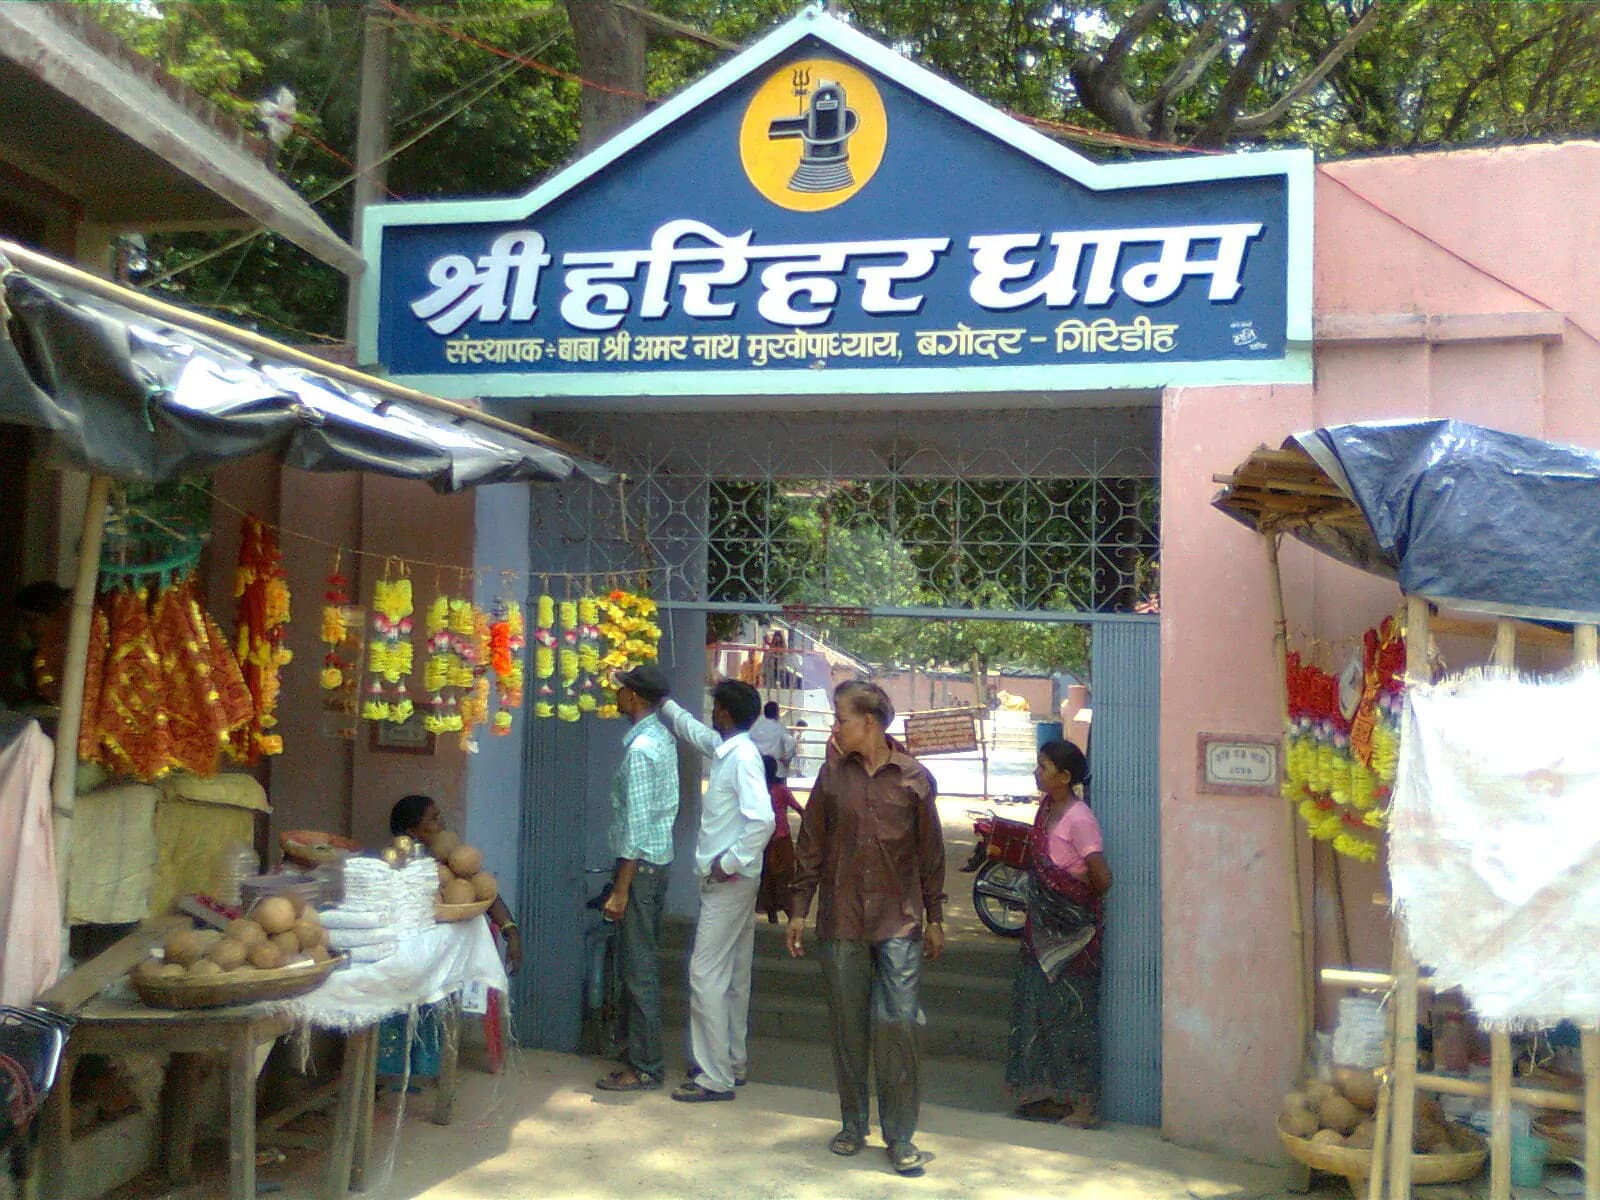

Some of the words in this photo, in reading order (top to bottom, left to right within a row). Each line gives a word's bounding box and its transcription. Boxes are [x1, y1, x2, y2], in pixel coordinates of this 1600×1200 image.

[409, 230, 551, 334] श्री
[559, 219, 950, 330] हरिहर
[968, 223, 1263, 309] धाम
[558, 337, 600, 362] बाबा
[602, 330, 631, 361] श्री
[633, 335, 688, 361] अमर
[692, 334, 740, 360] नाथ
[915, 322, 1027, 359] बगोदर
[1055, 315, 1179, 353] गिरिडीह
